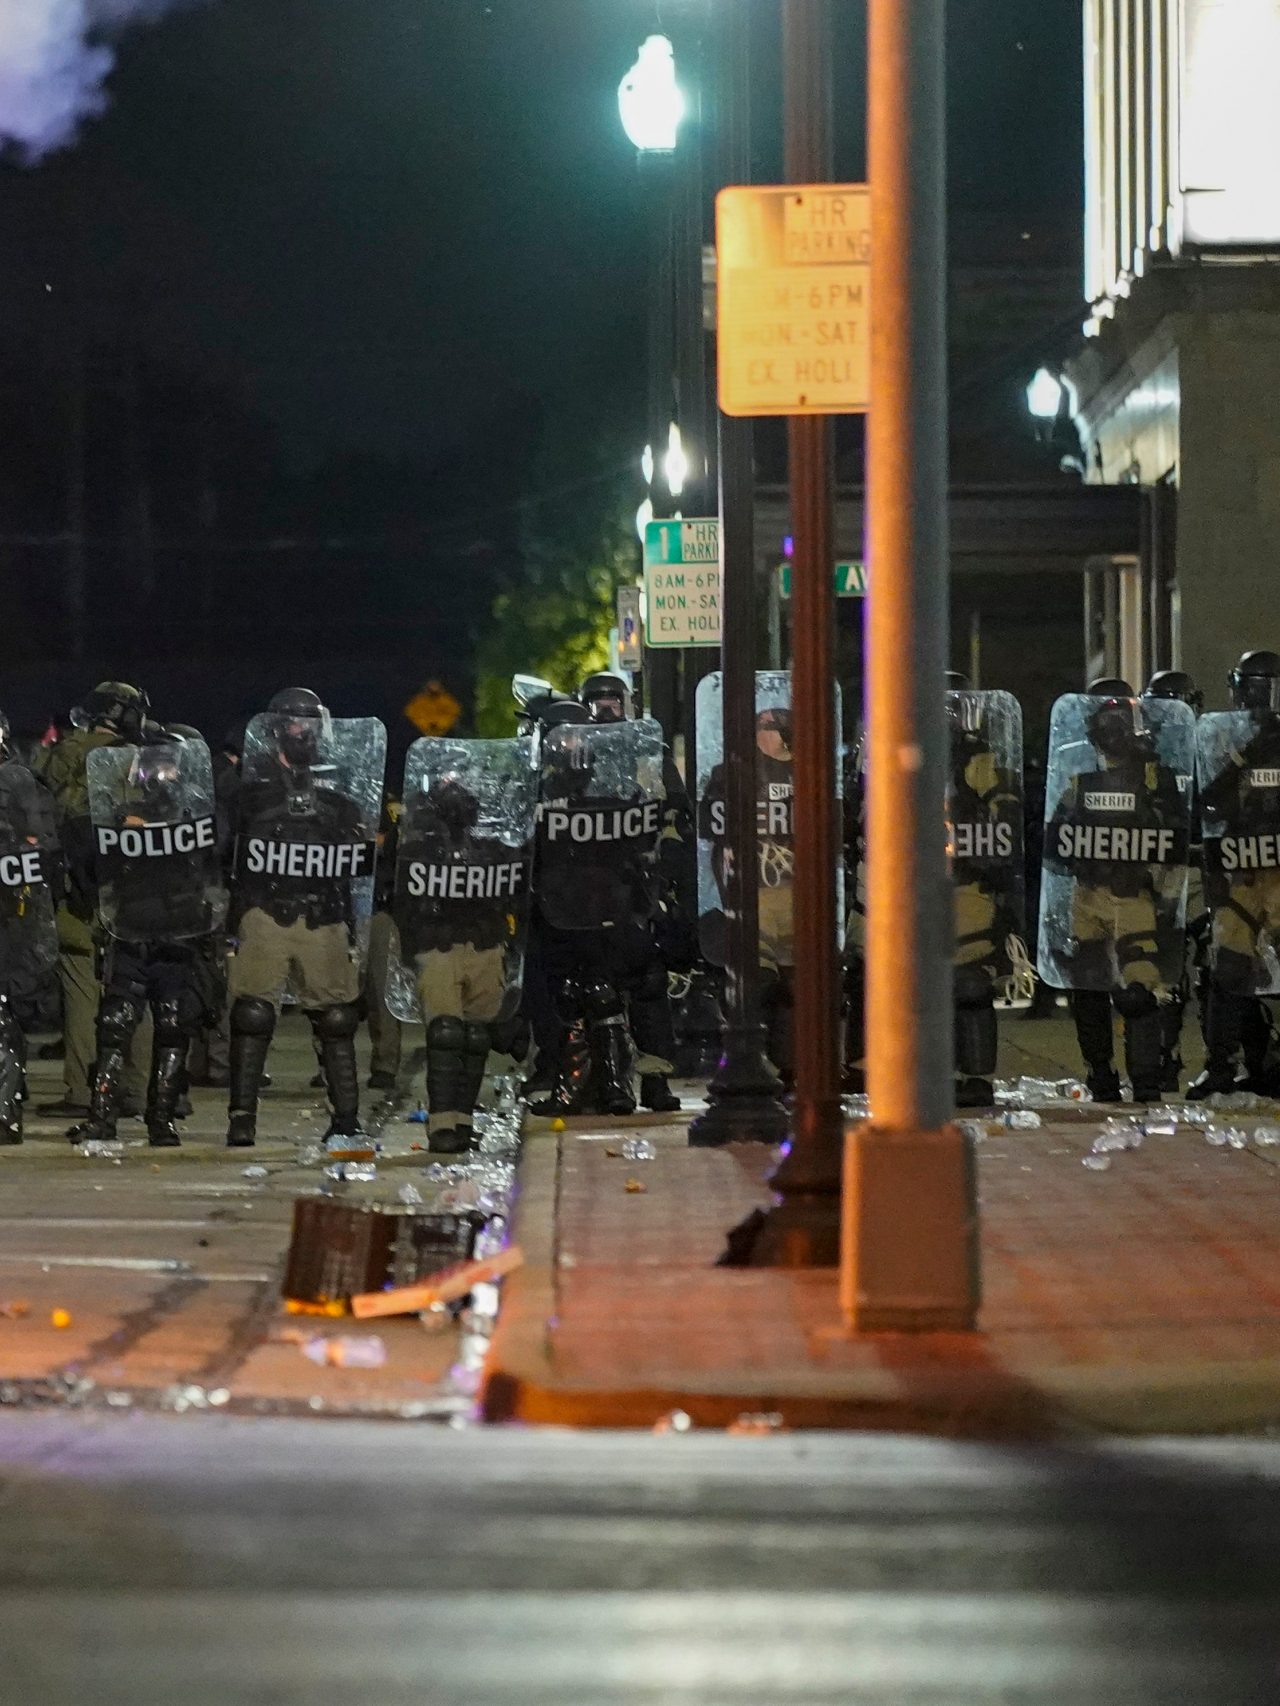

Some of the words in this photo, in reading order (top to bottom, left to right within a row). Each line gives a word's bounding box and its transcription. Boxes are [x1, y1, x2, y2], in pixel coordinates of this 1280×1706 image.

[810, 201, 846, 226] HR
[659, 526, 669, 561] 1
[696, 524, 718, 542] HR
[1084, 792, 1135, 810] SHERIFF
[97, 818, 215, 858] POLICE
[548, 803, 659, 843] POLICE
[247, 838, 367, 878] SHERIFF
[1057, 823, 1175, 863] SHERIFF
[1221, 834, 1280, 870] SHE
[407, 861, 524, 899] SHERIFF
